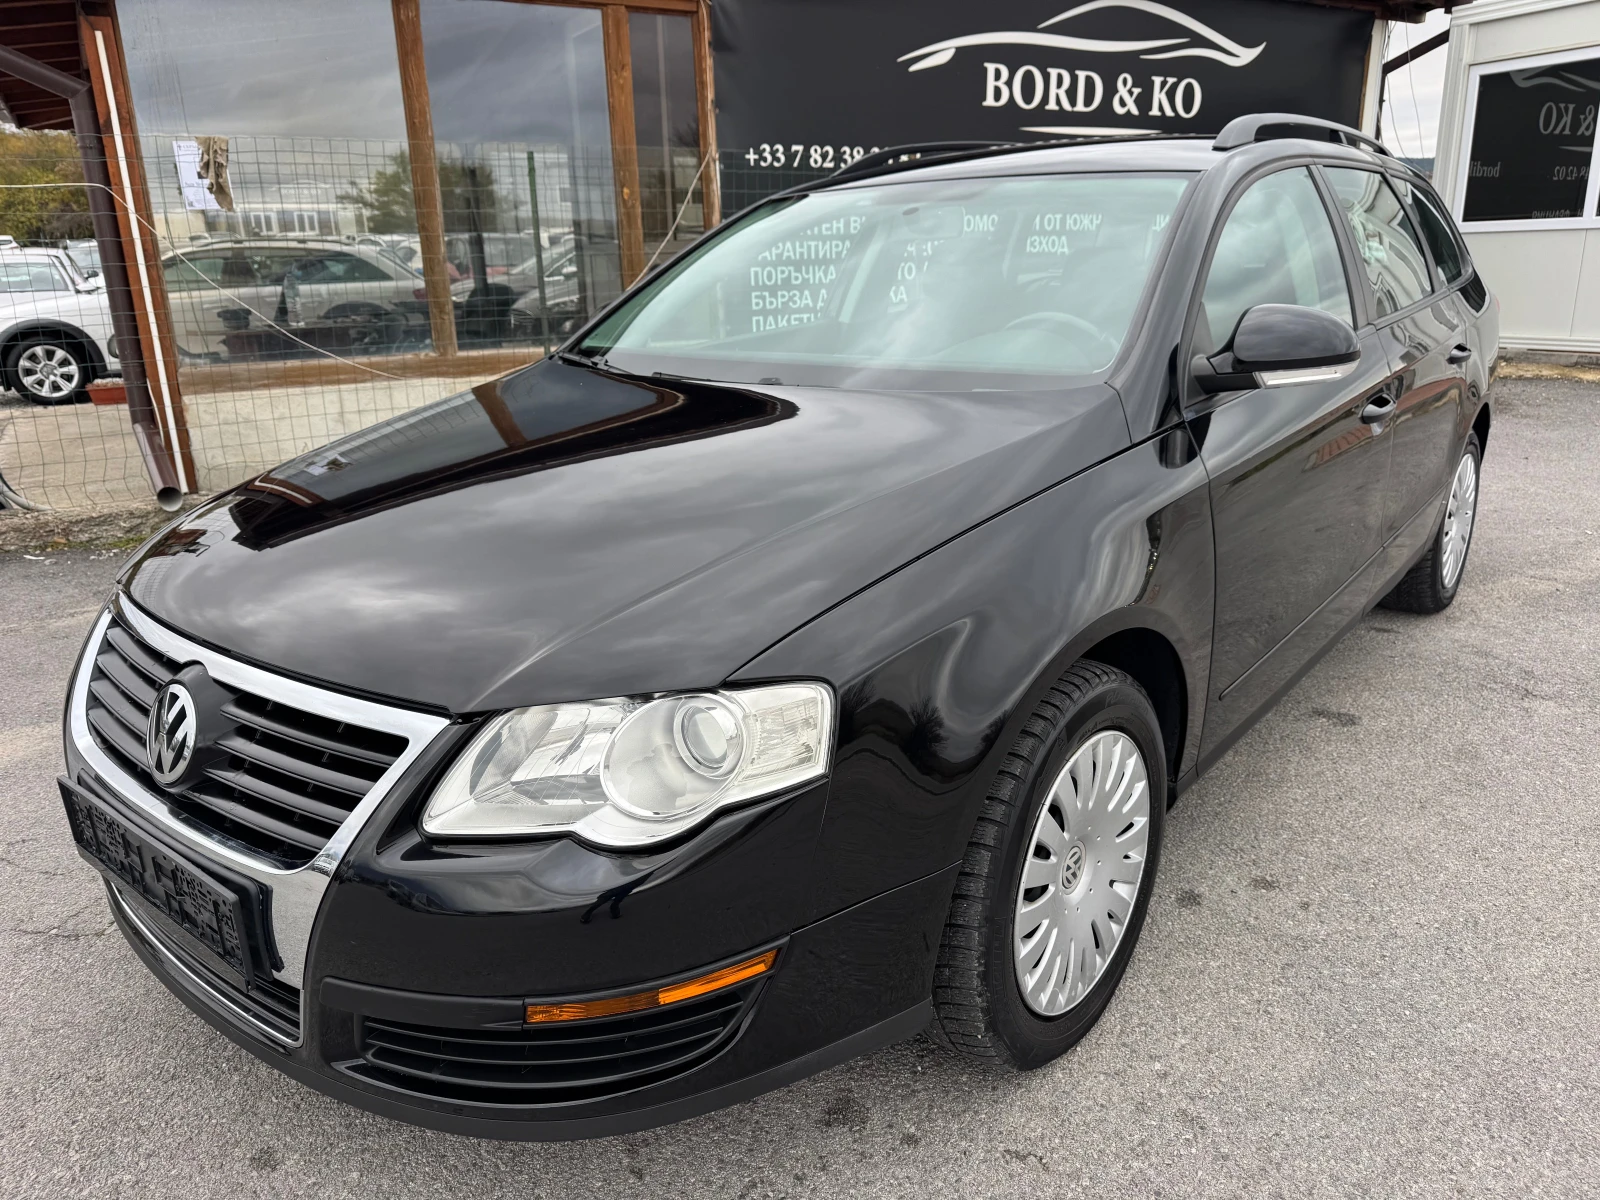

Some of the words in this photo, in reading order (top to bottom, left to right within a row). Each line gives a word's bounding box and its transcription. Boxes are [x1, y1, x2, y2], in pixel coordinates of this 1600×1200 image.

[982, 62, 1104, 112] BORD
[1112, 73, 1142, 116] &
[1148, 75, 1202, 119] KO
[745, 143, 786, 168] +33
[790, 144, 804, 168] 7
[809, 145, 835, 168] 82
[1044, 214, 1063, 231] ОТ
[750, 264, 836, 286] ПОРЪЧКА
[751, 289, 813, 311] БЪРЗА
